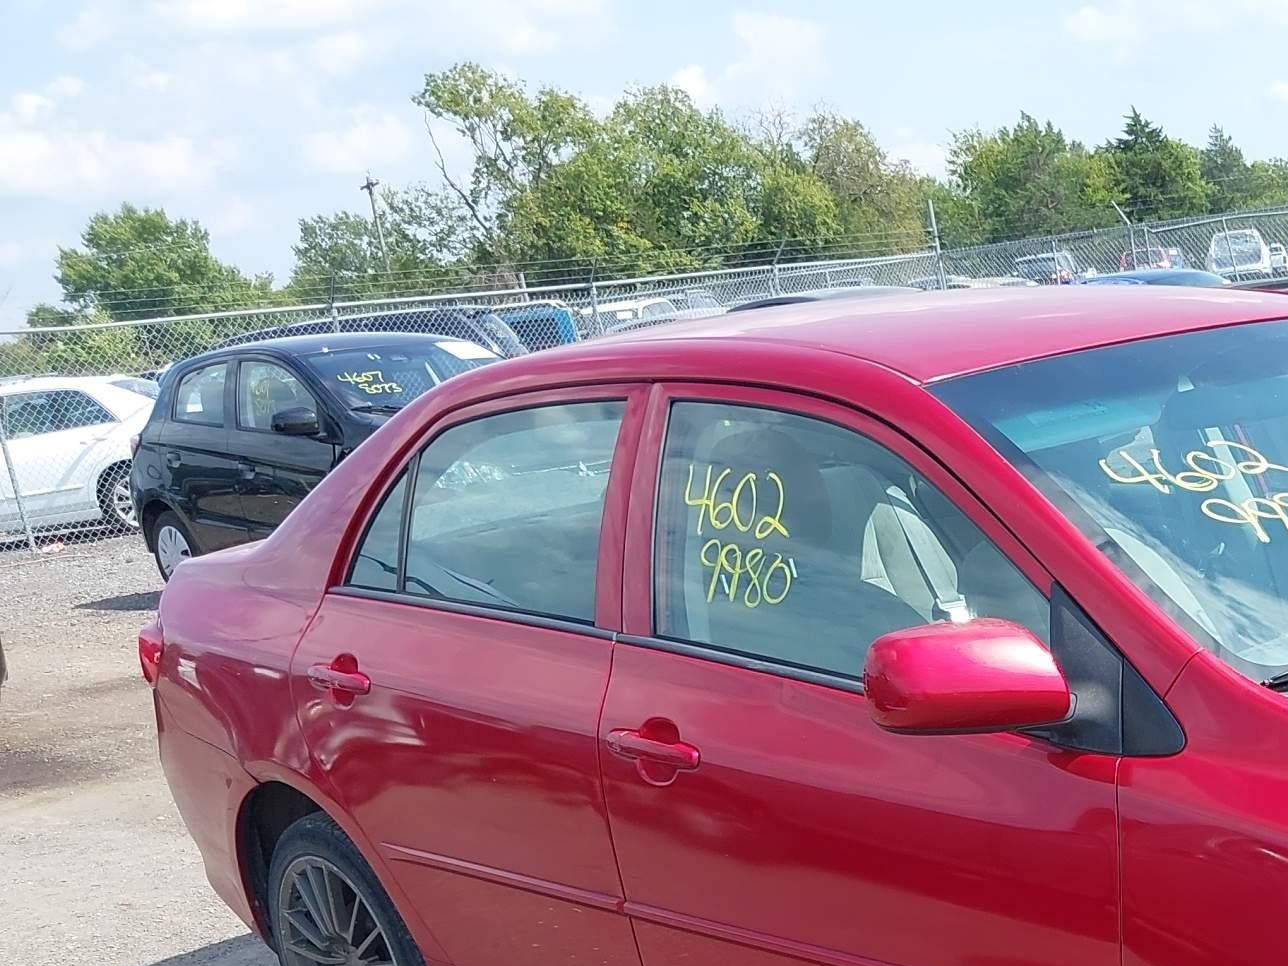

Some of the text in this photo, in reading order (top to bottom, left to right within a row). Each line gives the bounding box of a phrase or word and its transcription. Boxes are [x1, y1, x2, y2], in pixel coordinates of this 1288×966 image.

[336, 370, 384, 384] 4607
[684, 463, 790, 539] 4602
[700, 538, 792, 609] 9980
